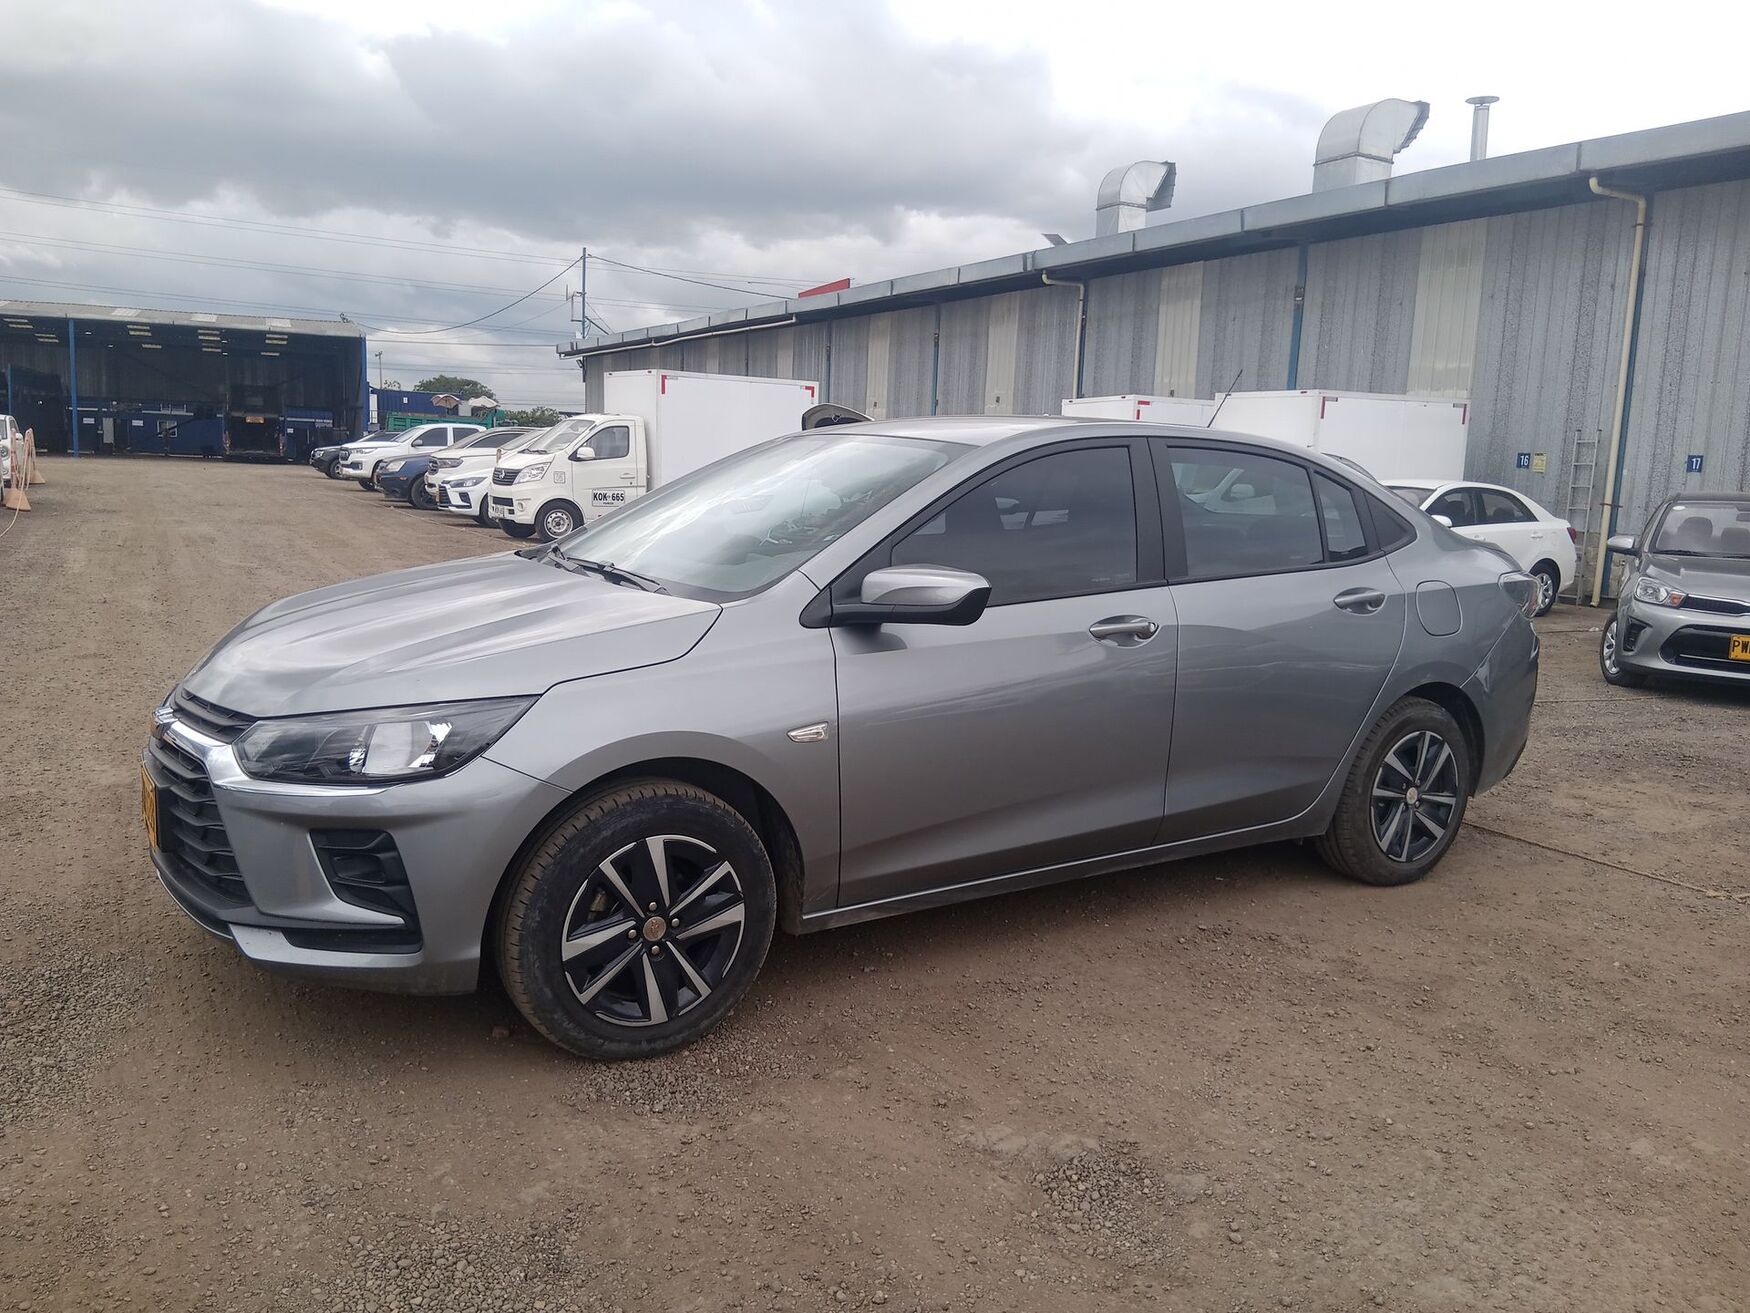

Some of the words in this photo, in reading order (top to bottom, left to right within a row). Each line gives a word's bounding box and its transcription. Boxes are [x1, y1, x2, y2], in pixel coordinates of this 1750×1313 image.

[1520, 455, 1530, 466] 16
[1691, 457, 1701, 469] 17
[1732, 639, 1750, 654] PW
